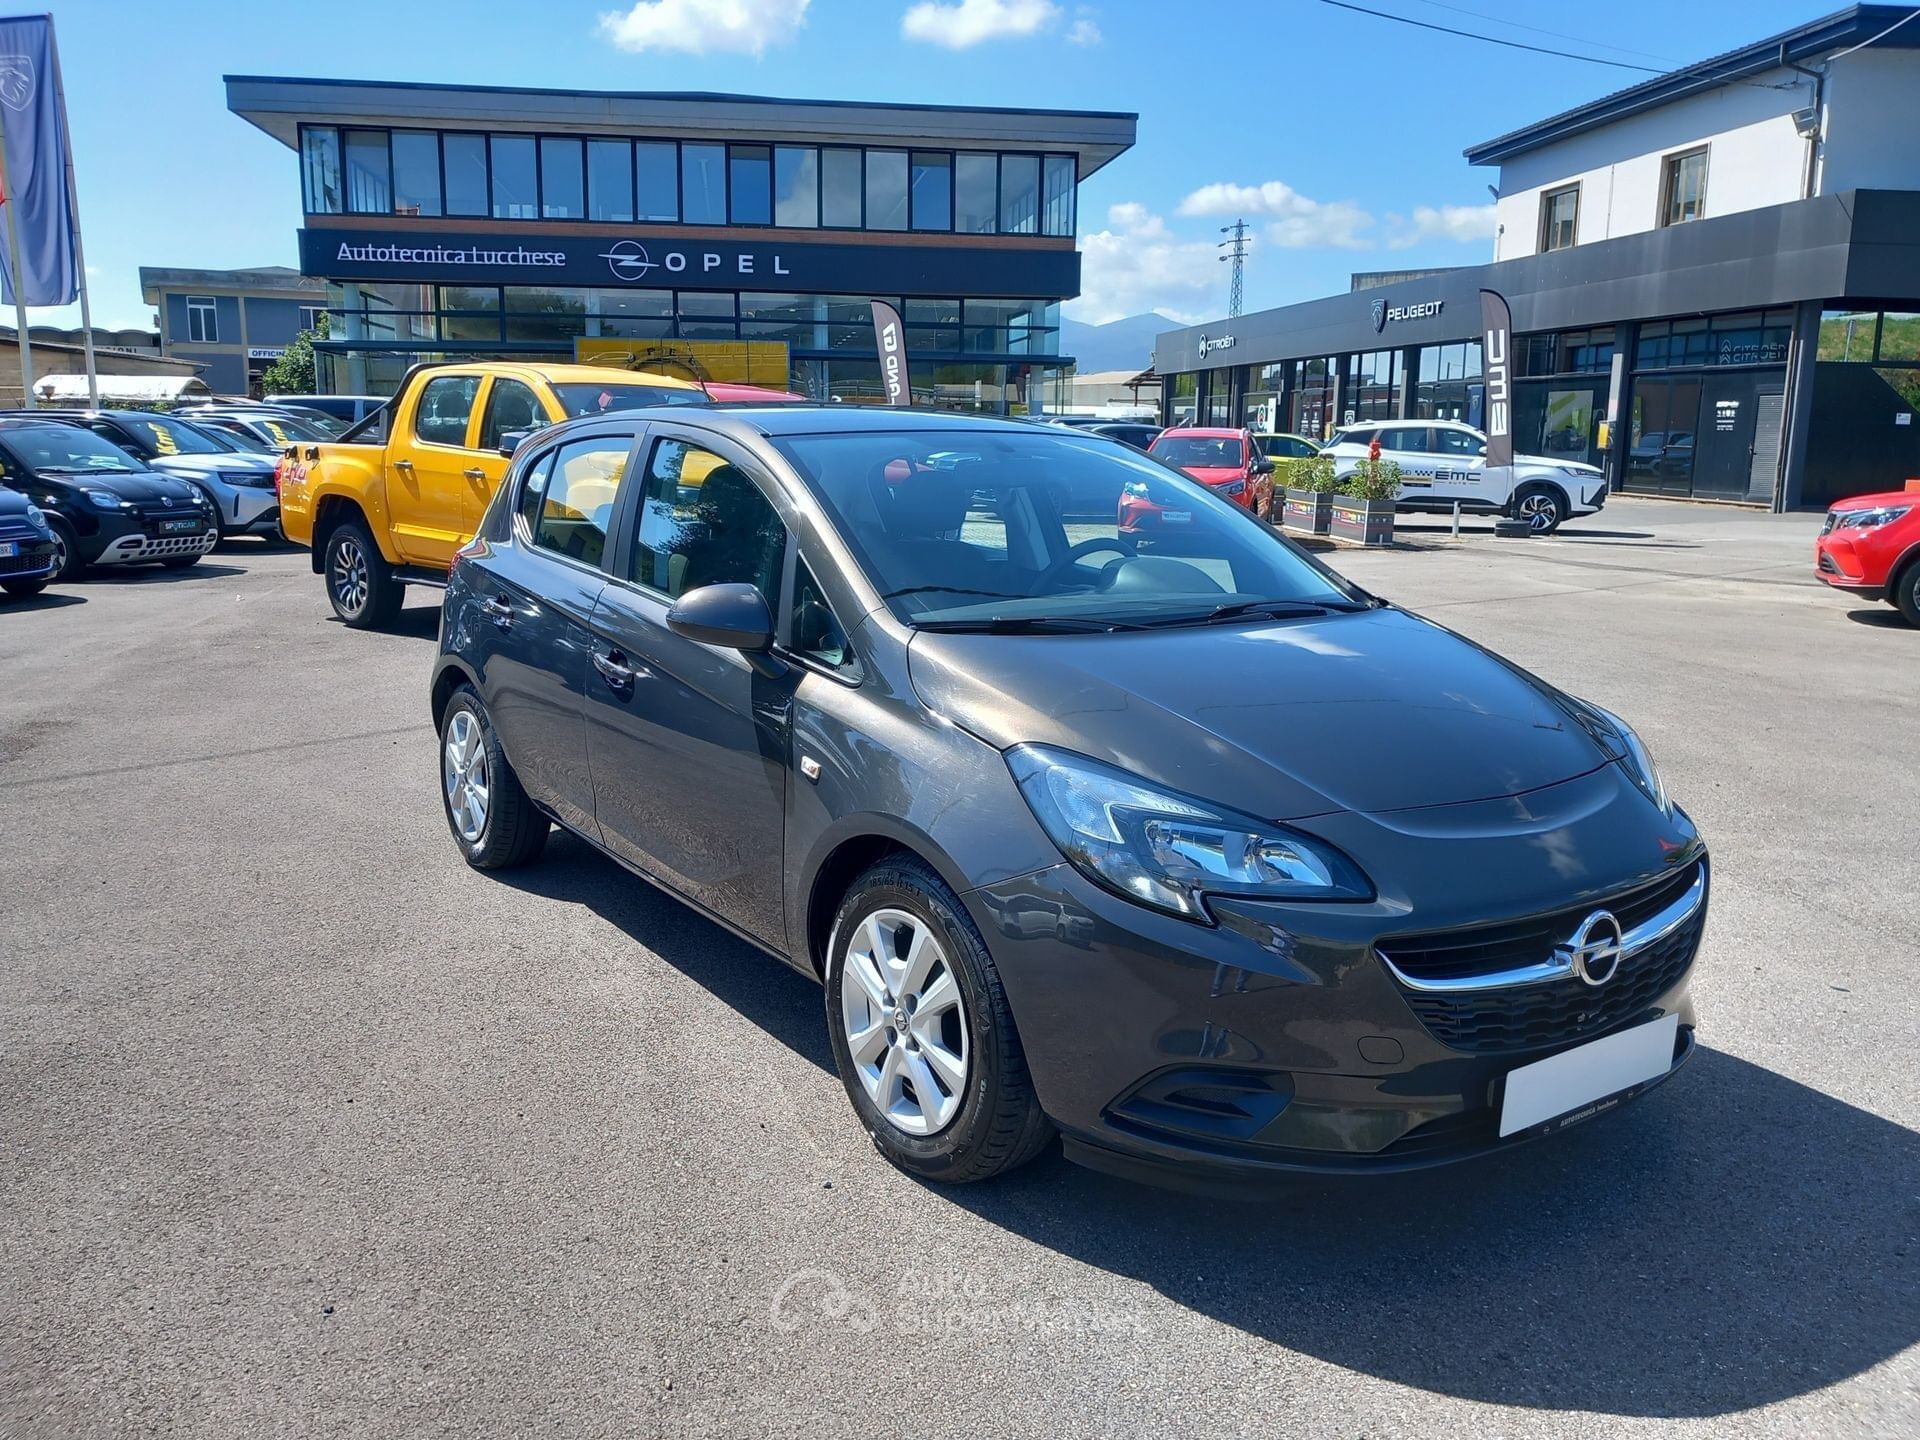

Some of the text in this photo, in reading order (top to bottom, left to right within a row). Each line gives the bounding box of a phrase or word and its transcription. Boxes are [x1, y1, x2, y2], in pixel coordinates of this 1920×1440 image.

[336, 242, 566, 266] Autotecnica Lucchese
[665, 252, 790, 276] OPEL
[1387, 301, 1443, 321] PEUGEOT
[1435, 471, 1481, 482] EMC
[165, 521, 196, 532] SPOTICAR
